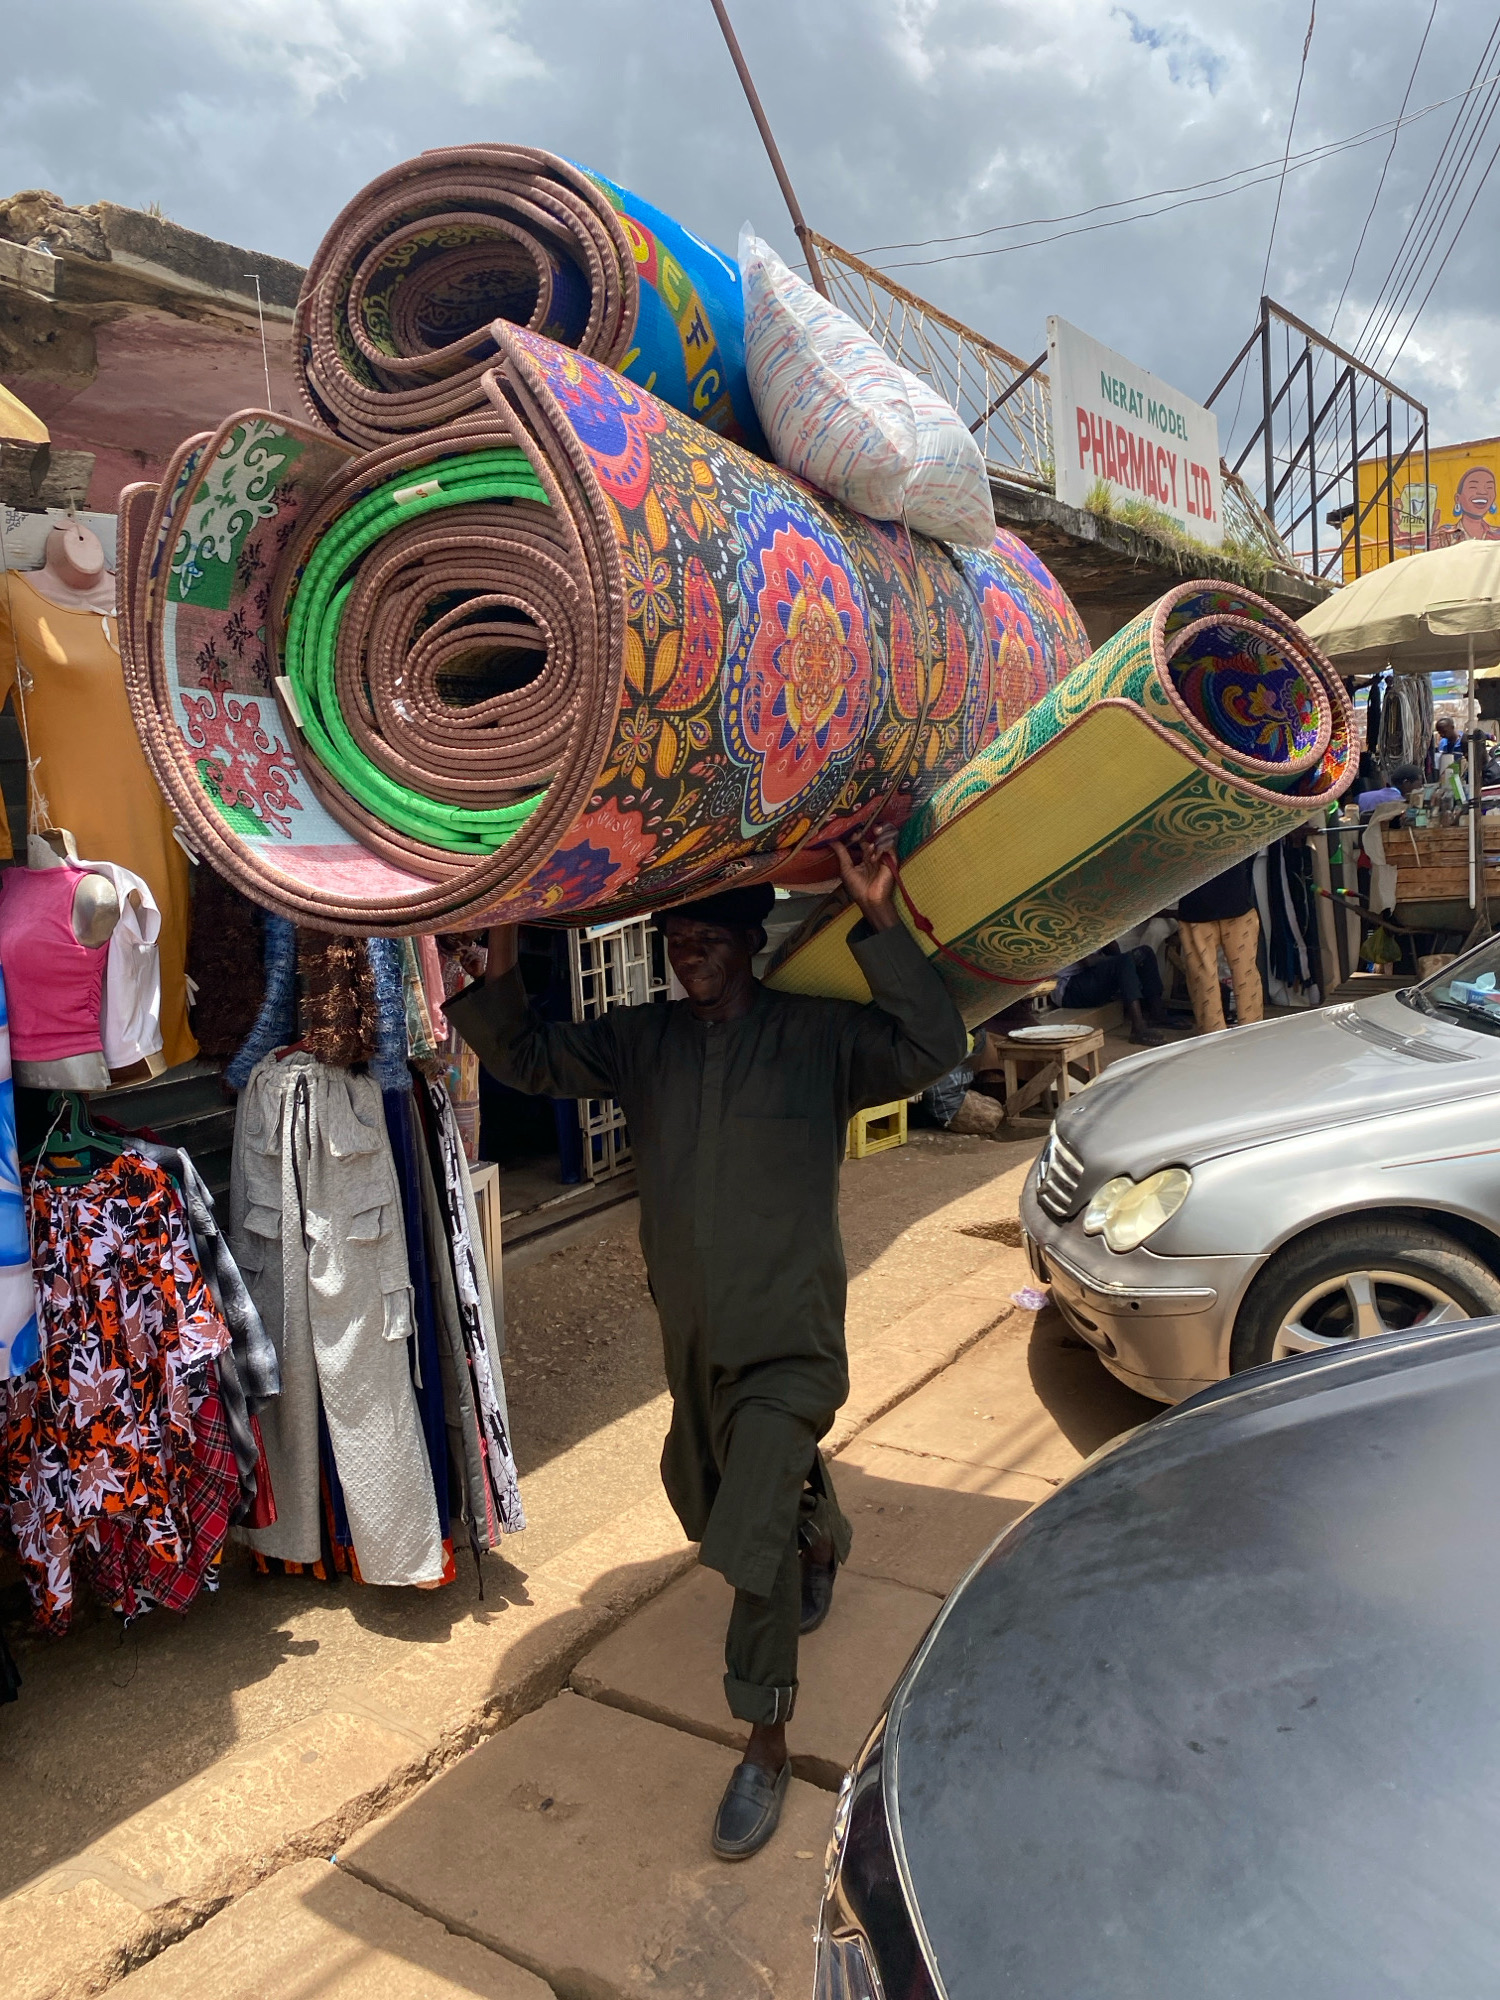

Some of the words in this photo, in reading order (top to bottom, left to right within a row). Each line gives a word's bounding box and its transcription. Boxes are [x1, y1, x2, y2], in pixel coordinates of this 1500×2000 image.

[1101, 371, 1143, 419] NERAT
[1148, 398, 1188, 441] MODEL
[1076, 406, 1177, 508] PHARMACY
[1184, 458, 1217, 523] LTD.
